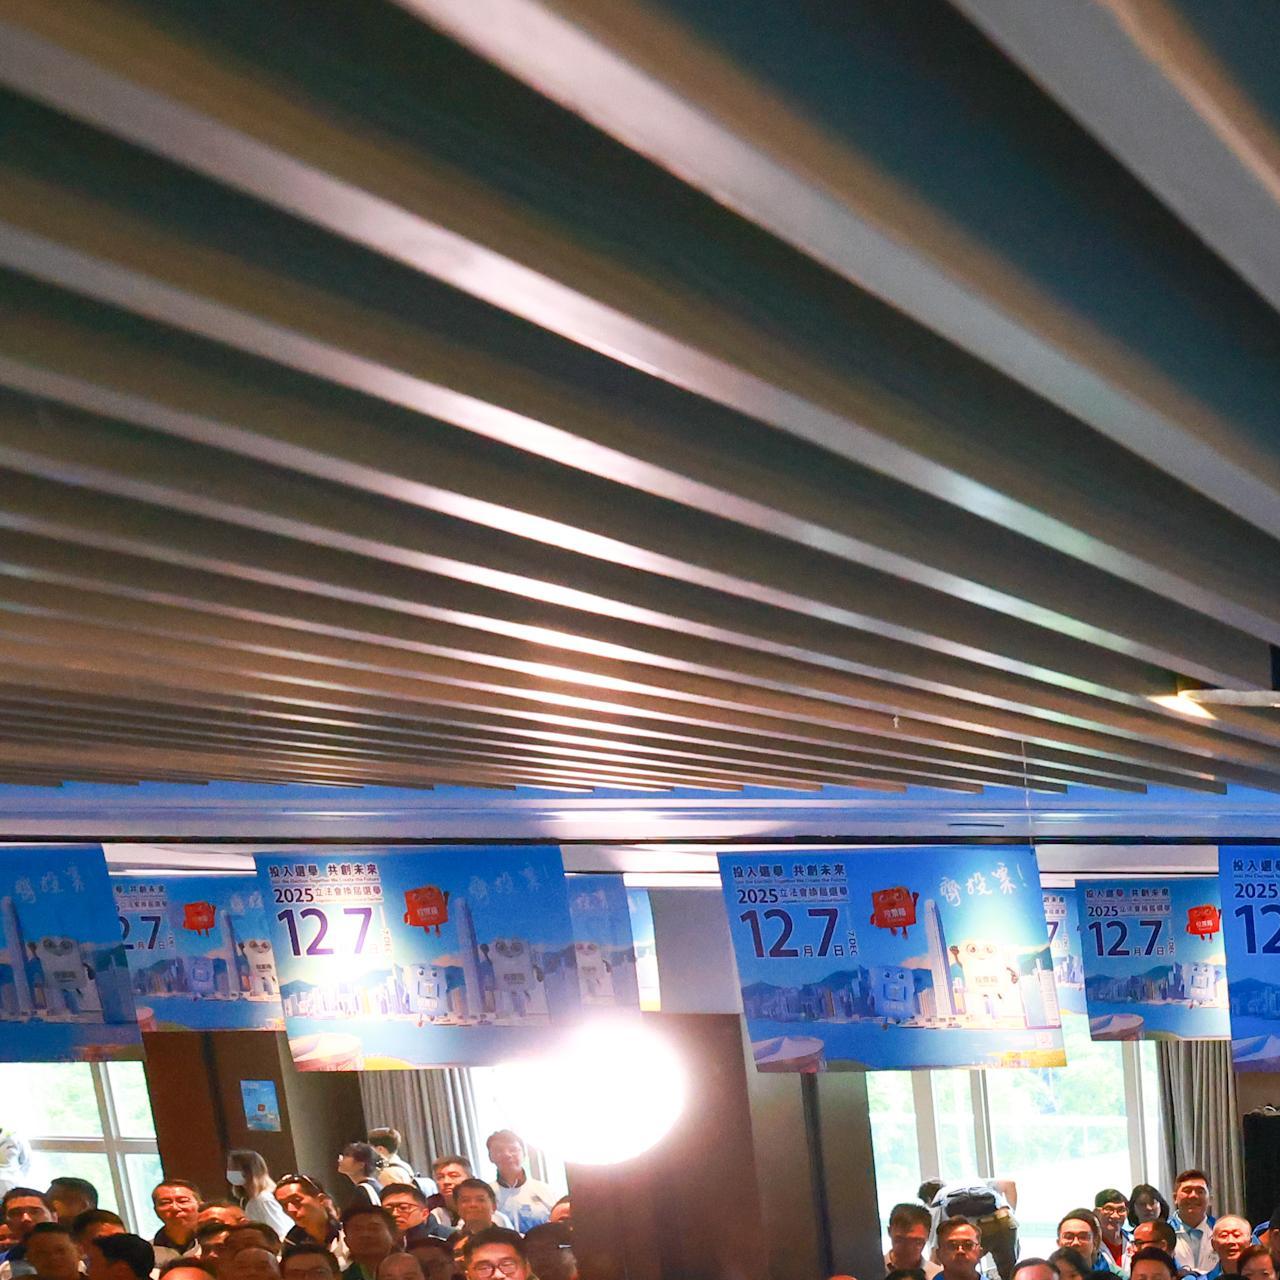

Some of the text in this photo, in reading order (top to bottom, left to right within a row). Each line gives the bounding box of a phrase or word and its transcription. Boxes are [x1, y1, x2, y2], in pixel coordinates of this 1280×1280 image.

[274, 888, 314, 903] 2025
[737, 888, 779, 904] 2025
[1234, 883, 1278, 898] 2025
[1088, 906, 1118, 917] 2025
[740, 908, 844, 958] 12月7日
[1088, 920, 1164, 956] 12月7日
